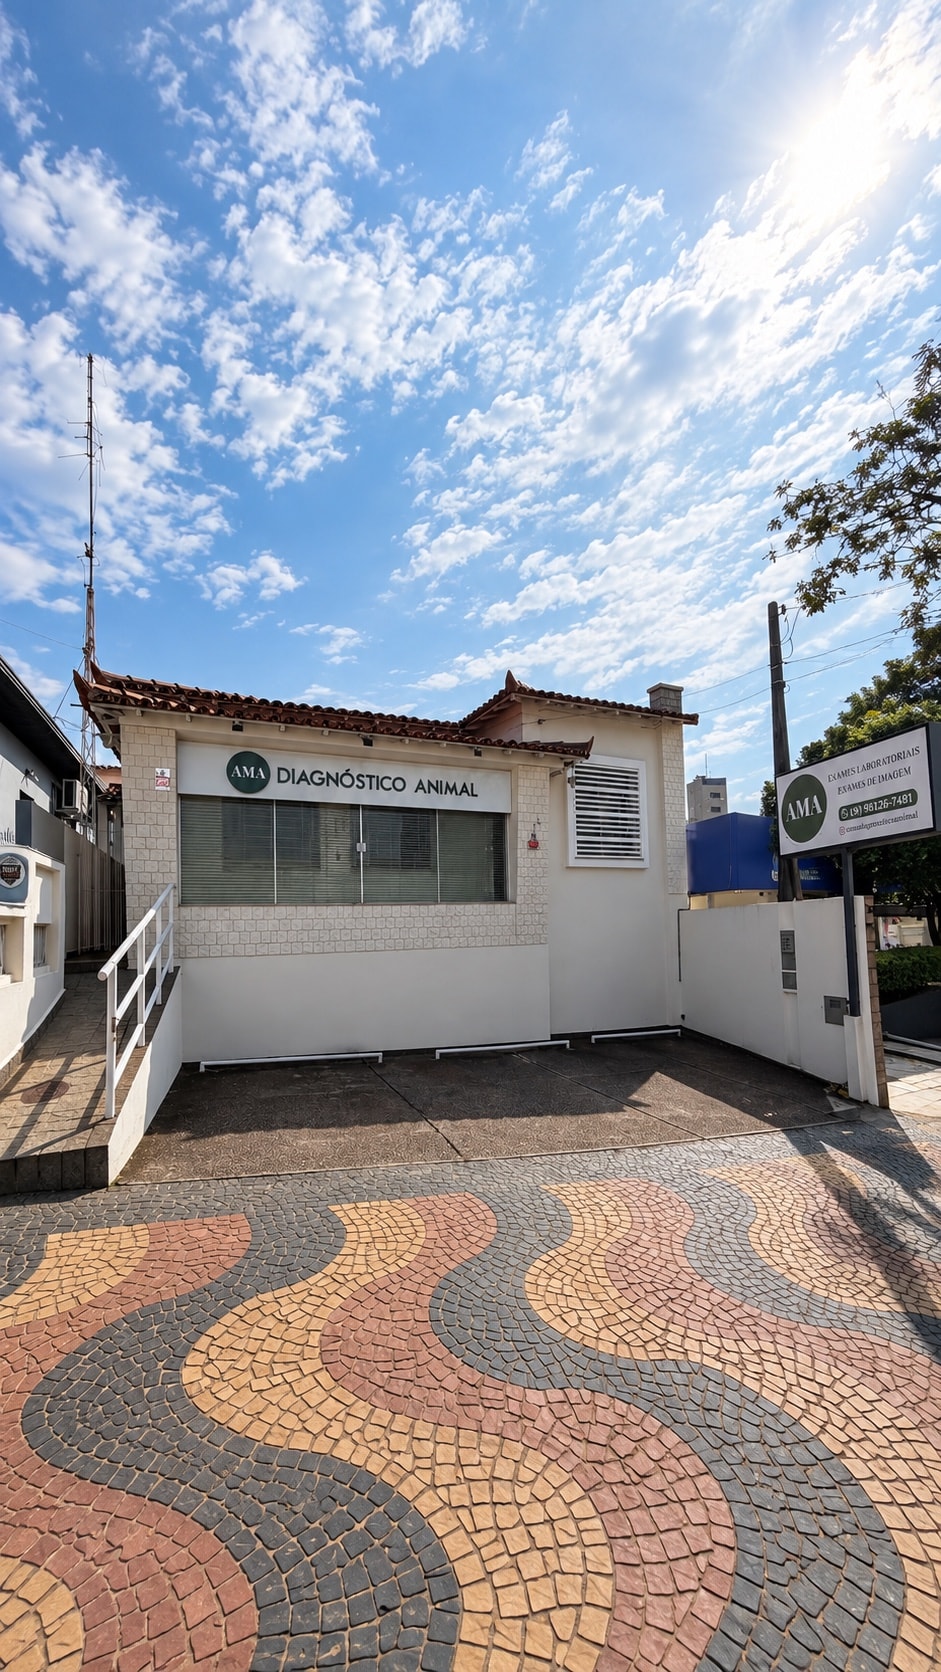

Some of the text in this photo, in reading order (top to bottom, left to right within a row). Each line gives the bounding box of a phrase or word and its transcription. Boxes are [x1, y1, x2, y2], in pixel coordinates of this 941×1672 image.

[827, 745, 921, 783] EXAMES LABORATORIAIS
[231, 764, 478, 798] AMA DIAGNÓSTICO ANIMAL
[837, 766, 912, 795] EXAMES DE IMAGEM
[785, 794, 823, 822] AMA
